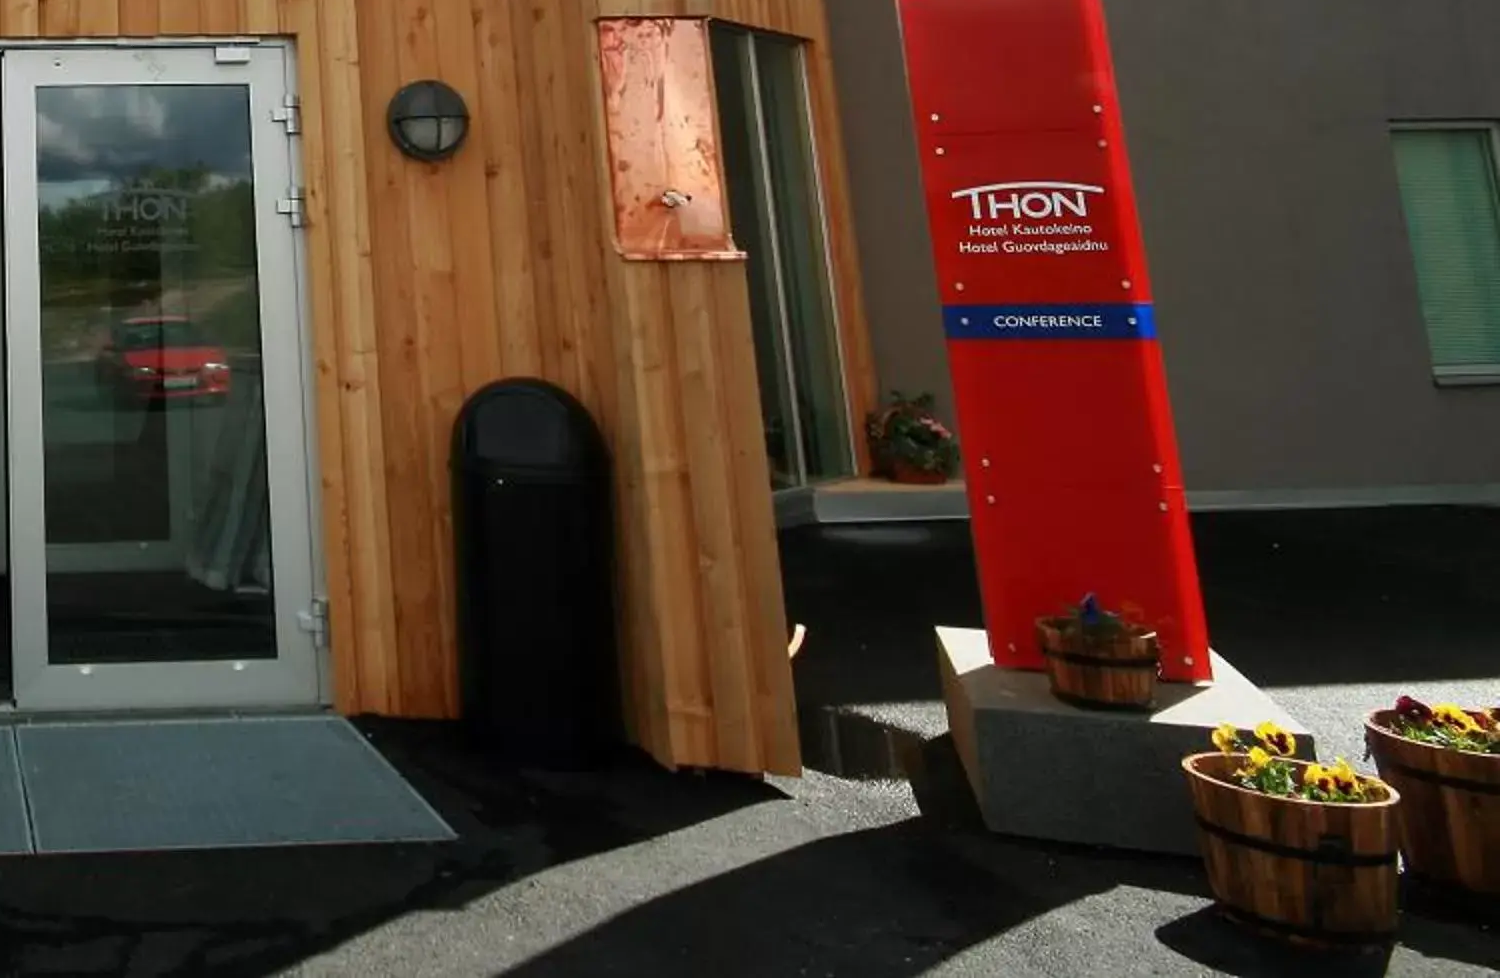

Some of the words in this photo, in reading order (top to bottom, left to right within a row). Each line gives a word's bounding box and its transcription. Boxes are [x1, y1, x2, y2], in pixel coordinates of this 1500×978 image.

[952, 181, 1104, 219] THON
[969, 224, 1008, 236] Hotel
[1013, 223, 1092, 235] Kautokeino
[959, 241, 998, 253] Hotel
[993, 315, 1102, 327] CONFERENCE
